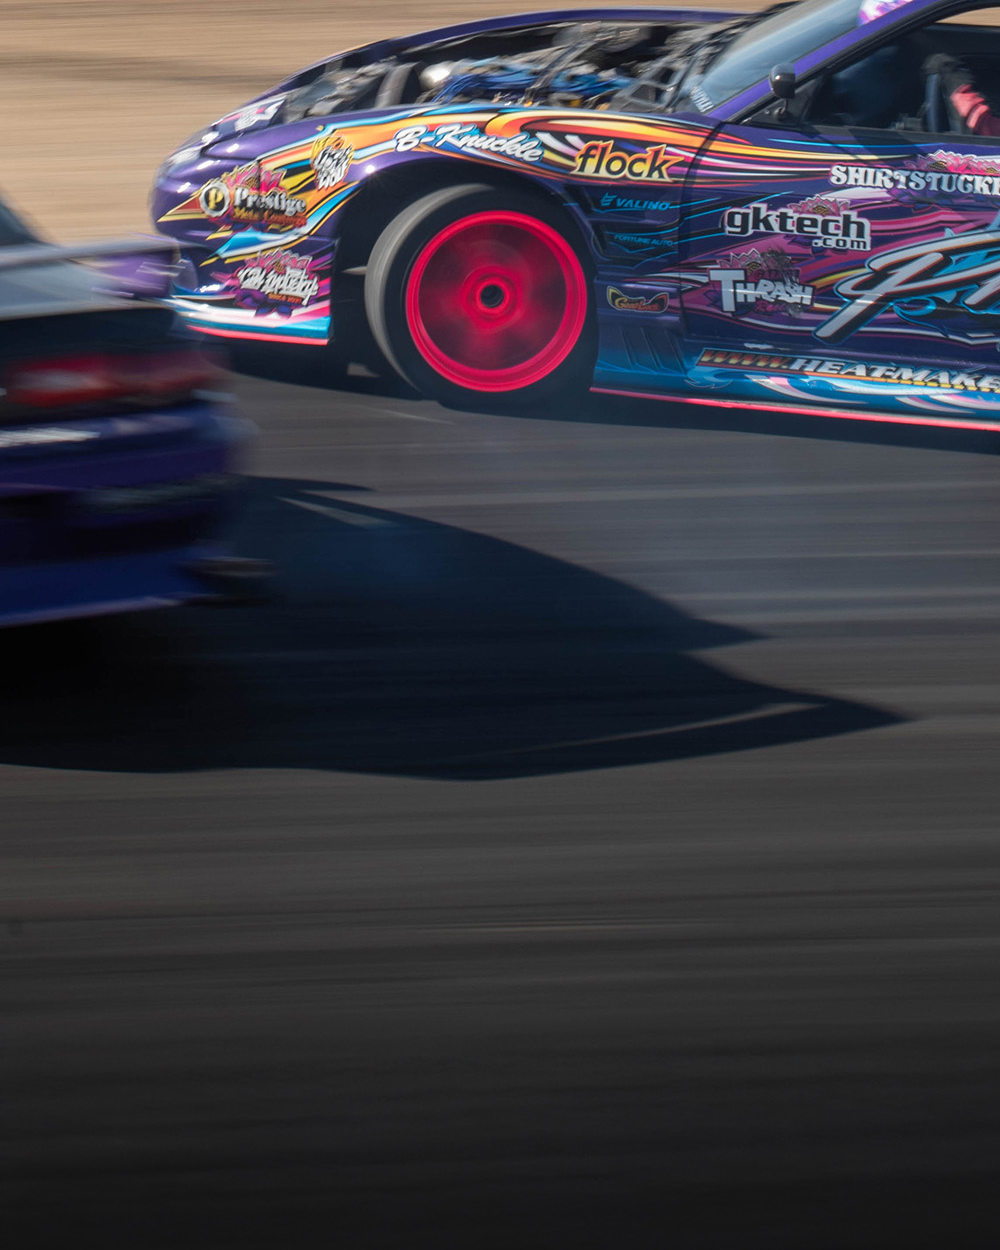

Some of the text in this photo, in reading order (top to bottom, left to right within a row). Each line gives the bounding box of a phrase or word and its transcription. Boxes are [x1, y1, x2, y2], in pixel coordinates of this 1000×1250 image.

[395, 123, 543, 162] B-Knuckle
[577, 141, 673, 181] flock
[234, 187, 306, 216] Prestige
[616, 198, 672, 211] VALINO
[726, 206, 865, 238] gktech
[614, 234, 674, 247] FORTUNE AUTO
[813, 237, 868, 250] .com
